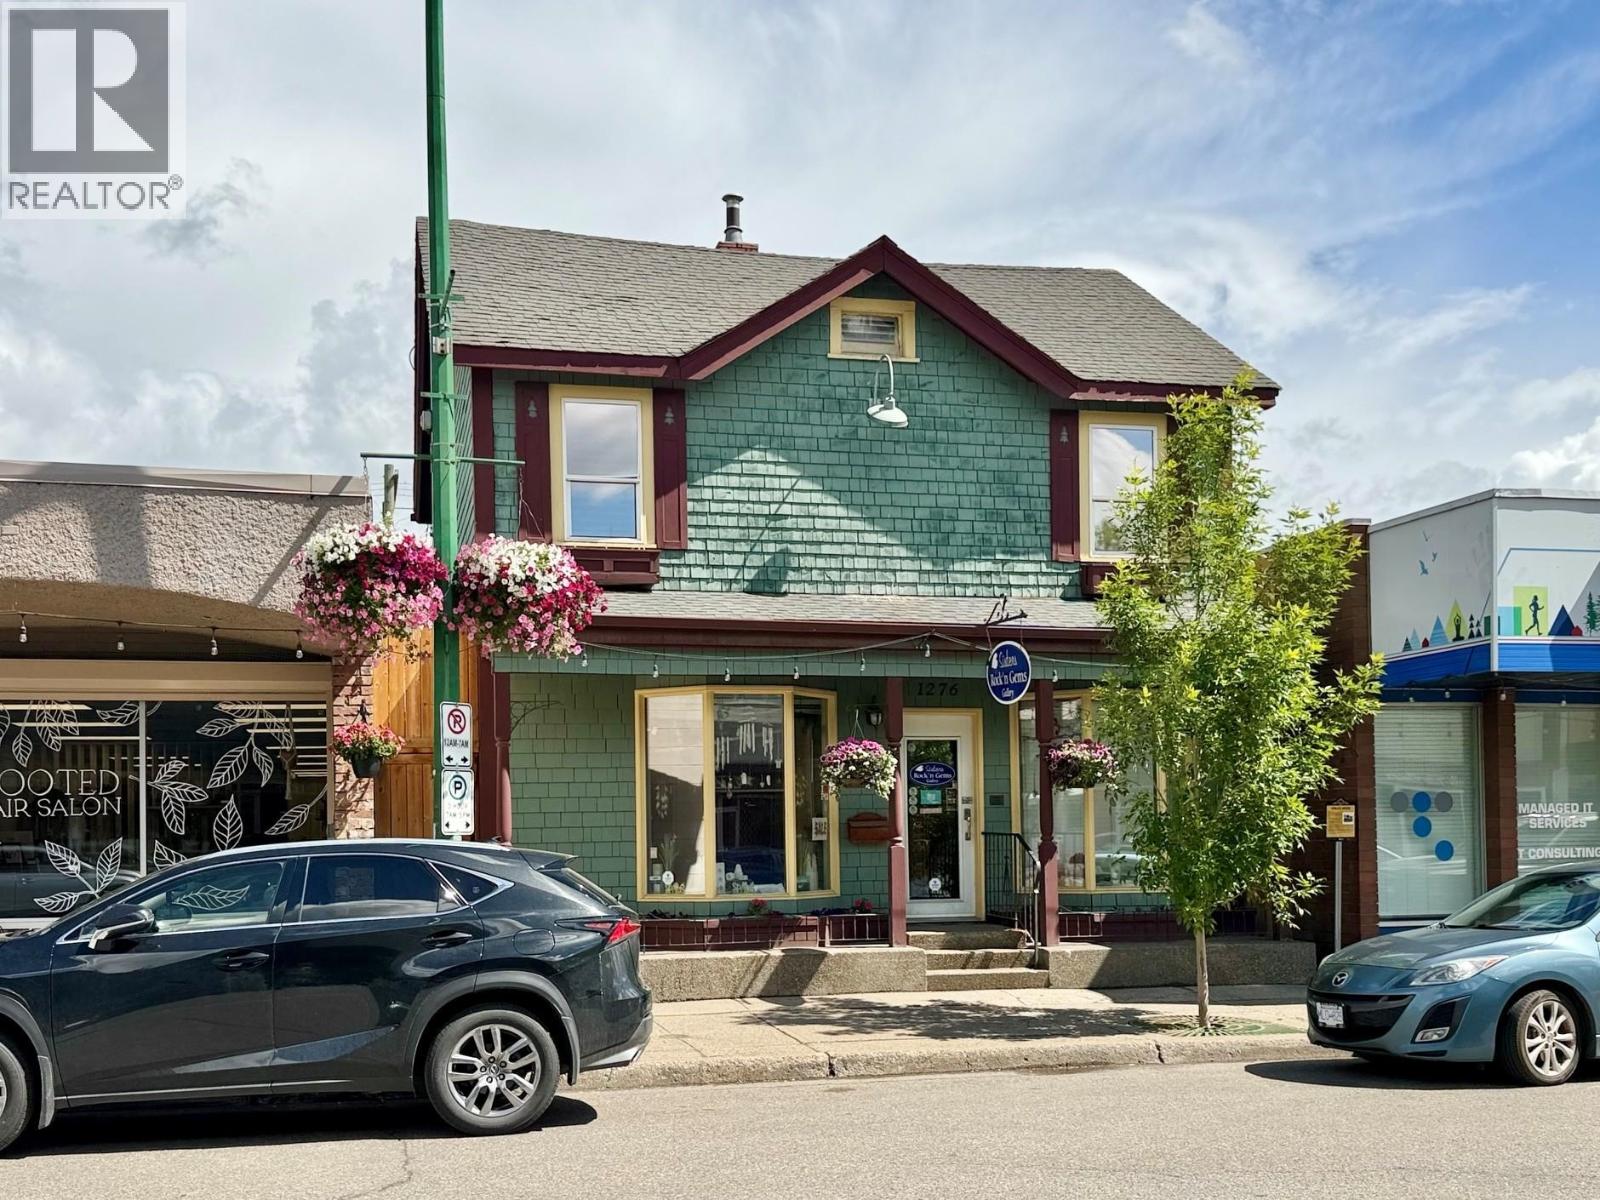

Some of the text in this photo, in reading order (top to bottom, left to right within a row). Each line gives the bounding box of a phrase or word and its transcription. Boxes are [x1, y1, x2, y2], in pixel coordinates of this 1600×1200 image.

[1009, 670, 1028, 684] Gems
[917, 682, 960, 696] 1276
[37, 796, 121, 817] SALON
[1518, 803, 1594, 814] MANAGED IT
[1529, 817, 1587, 828] SERVICES
[1528, 847, 1600, 859] CONSULTING
